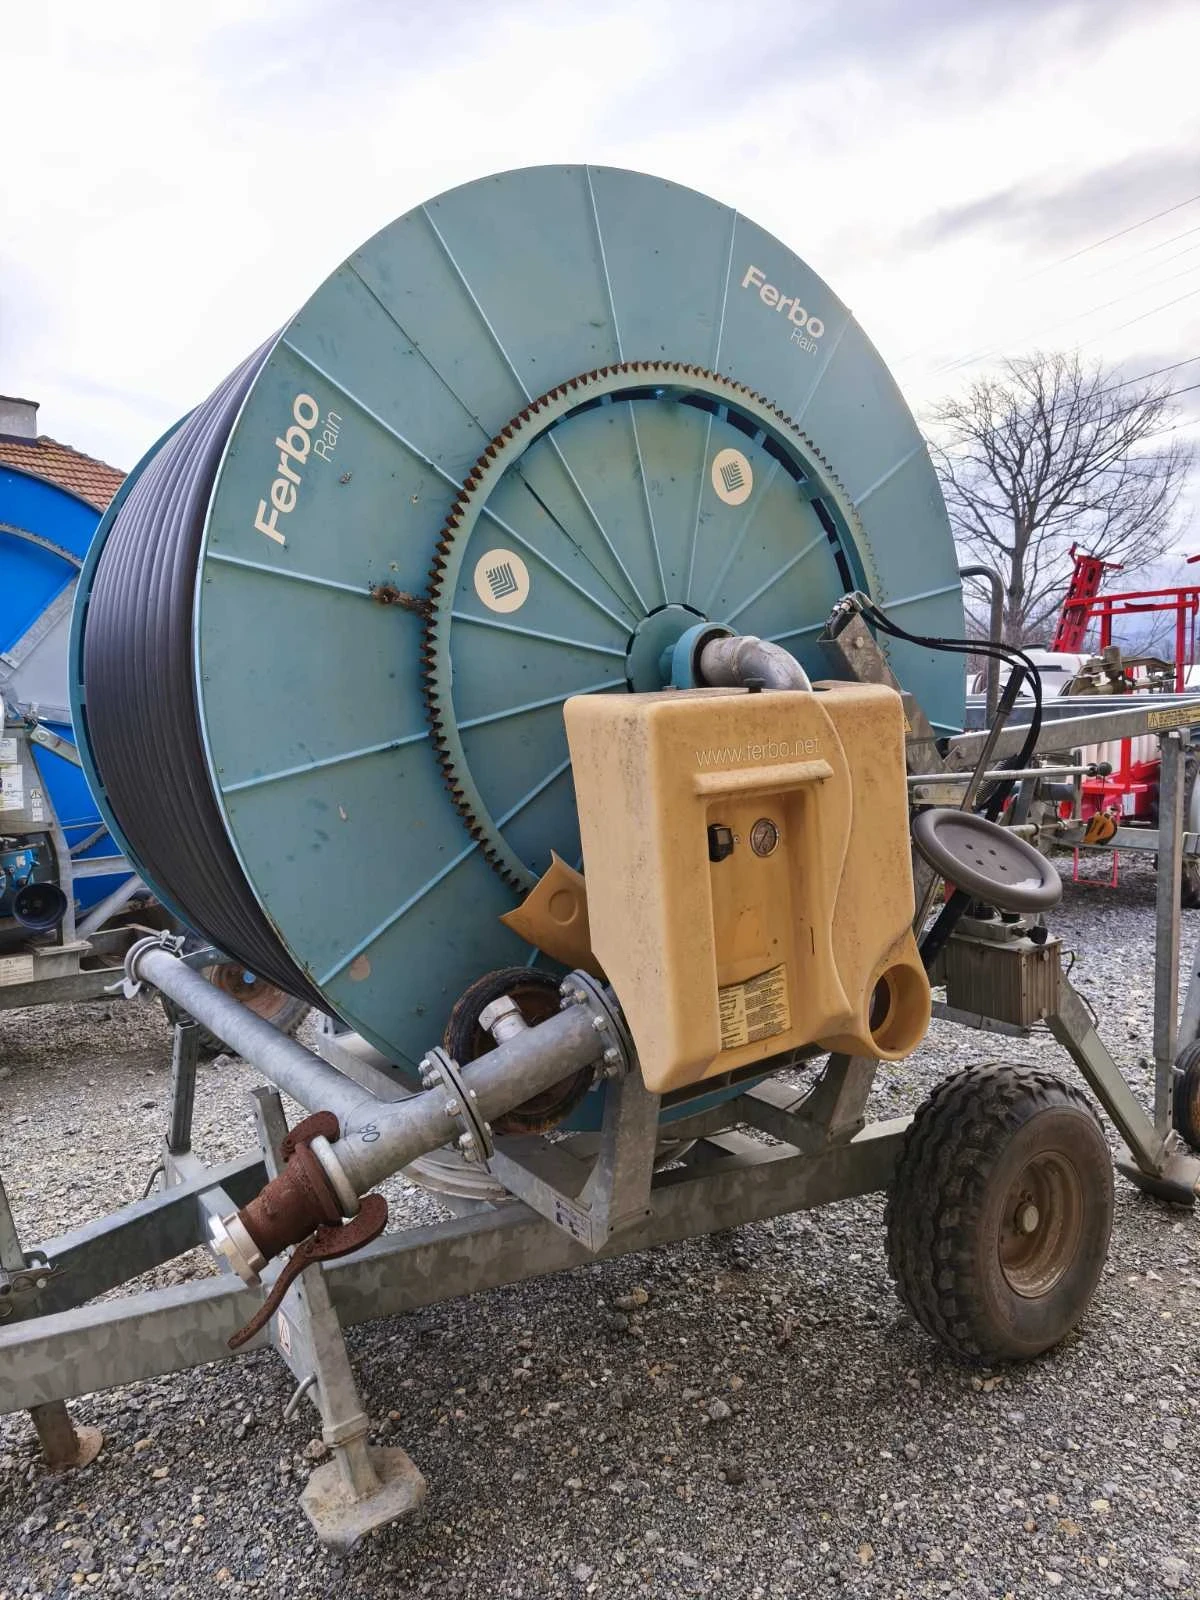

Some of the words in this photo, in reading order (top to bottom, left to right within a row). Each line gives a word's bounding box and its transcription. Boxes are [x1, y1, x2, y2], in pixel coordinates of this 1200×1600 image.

[742, 265, 825, 338] Ferbo
[790, 328, 818, 355] Rain
[314, 411, 343, 463] Rain
[254, 393, 319, 545] Ferbo
[695, 736, 822, 768] www.ferbo.net
